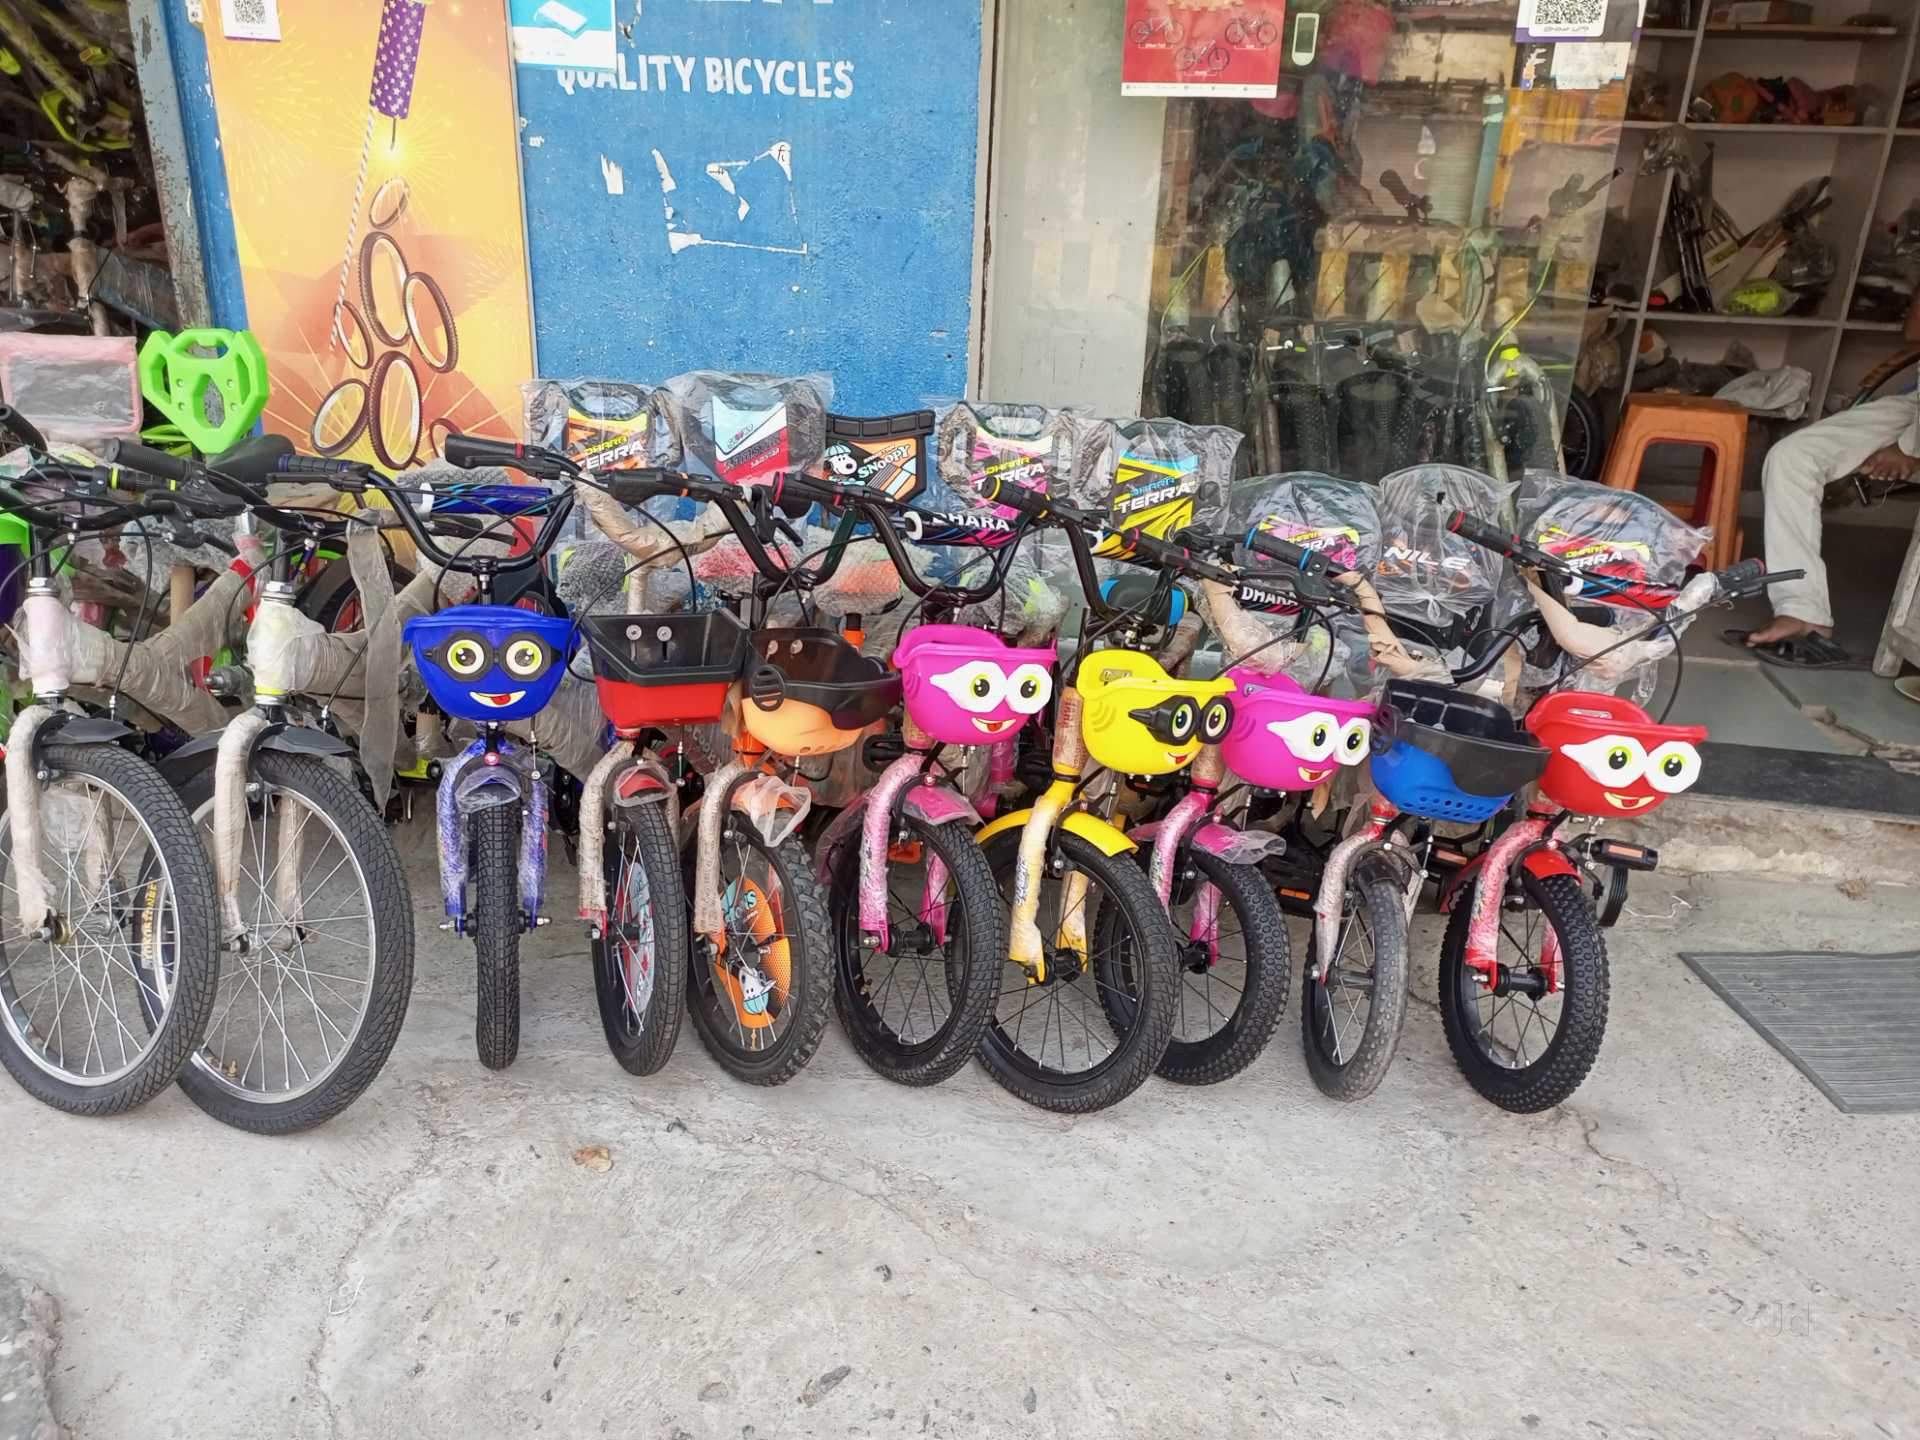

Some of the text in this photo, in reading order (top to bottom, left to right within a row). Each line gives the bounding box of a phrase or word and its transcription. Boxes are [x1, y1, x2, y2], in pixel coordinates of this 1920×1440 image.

[703, 56, 855, 99] BICYCLES
[857, 444, 911, 478] SNOOPY
[974, 462, 1045, 491] TRRA
[1118, 482, 1192, 514] TERRA
[1383, 546, 1472, 569] NILE
